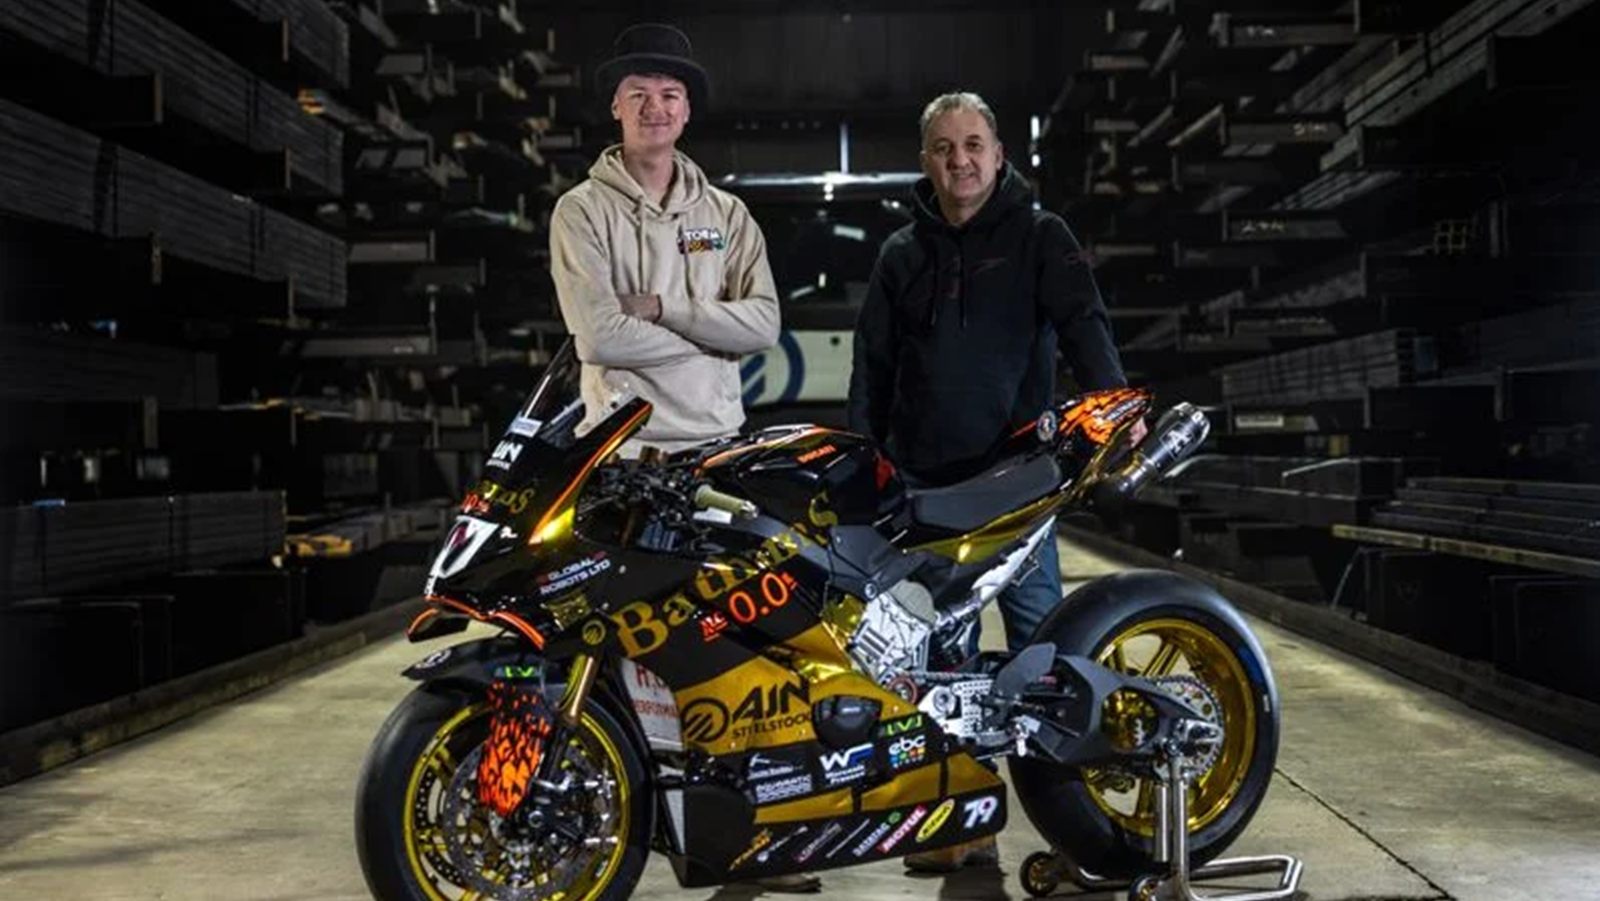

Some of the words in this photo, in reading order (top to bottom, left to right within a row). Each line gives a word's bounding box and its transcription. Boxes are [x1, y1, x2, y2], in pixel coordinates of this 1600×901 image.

[677, 228, 721, 241] TORM
[540, 570, 589, 595] ROBOTS
[588, 559, 612, 576] LTD
[547, 557, 596, 581] GLOBAL
[888, 734, 926, 756] ebc
[964, 796, 998, 829] 79
[882, 807, 927, 852] MOTUL
